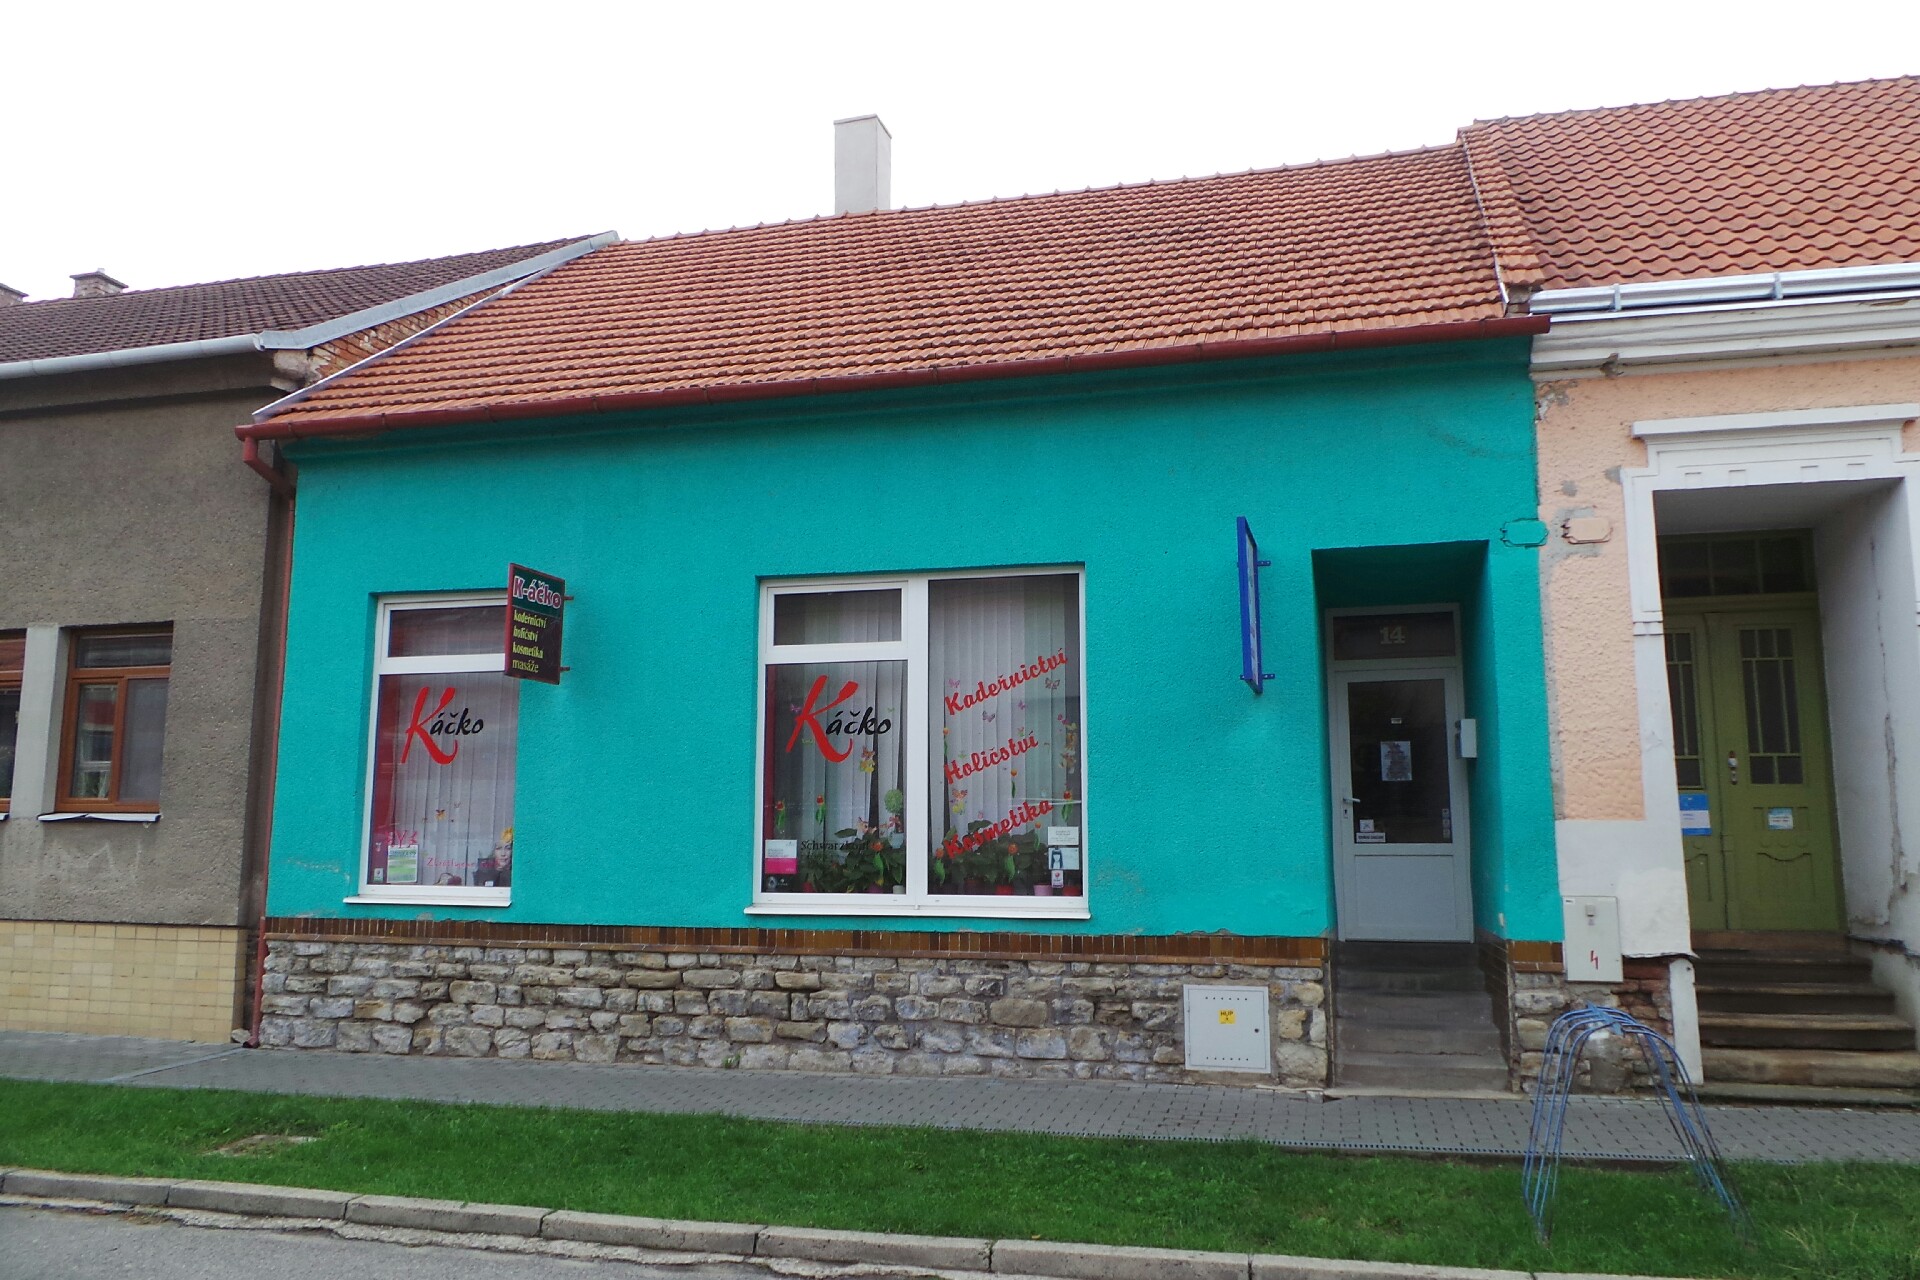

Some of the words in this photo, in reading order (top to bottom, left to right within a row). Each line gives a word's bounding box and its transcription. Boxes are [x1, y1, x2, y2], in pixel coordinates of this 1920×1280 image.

[513, 575, 561, 608] K-áčko
[512, 641, 544, 659] kosmetika
[1379, 626, 1406, 645] 14
[512, 659, 539, 673] masáže
[944, 647, 1069, 716] Kadeřnictví
[401, 686, 484, 765] Káčko
[785, 675, 892, 763] Káčko
[944, 730, 1039, 785] Holičství
[943, 800, 1055, 859] Kosmetika
